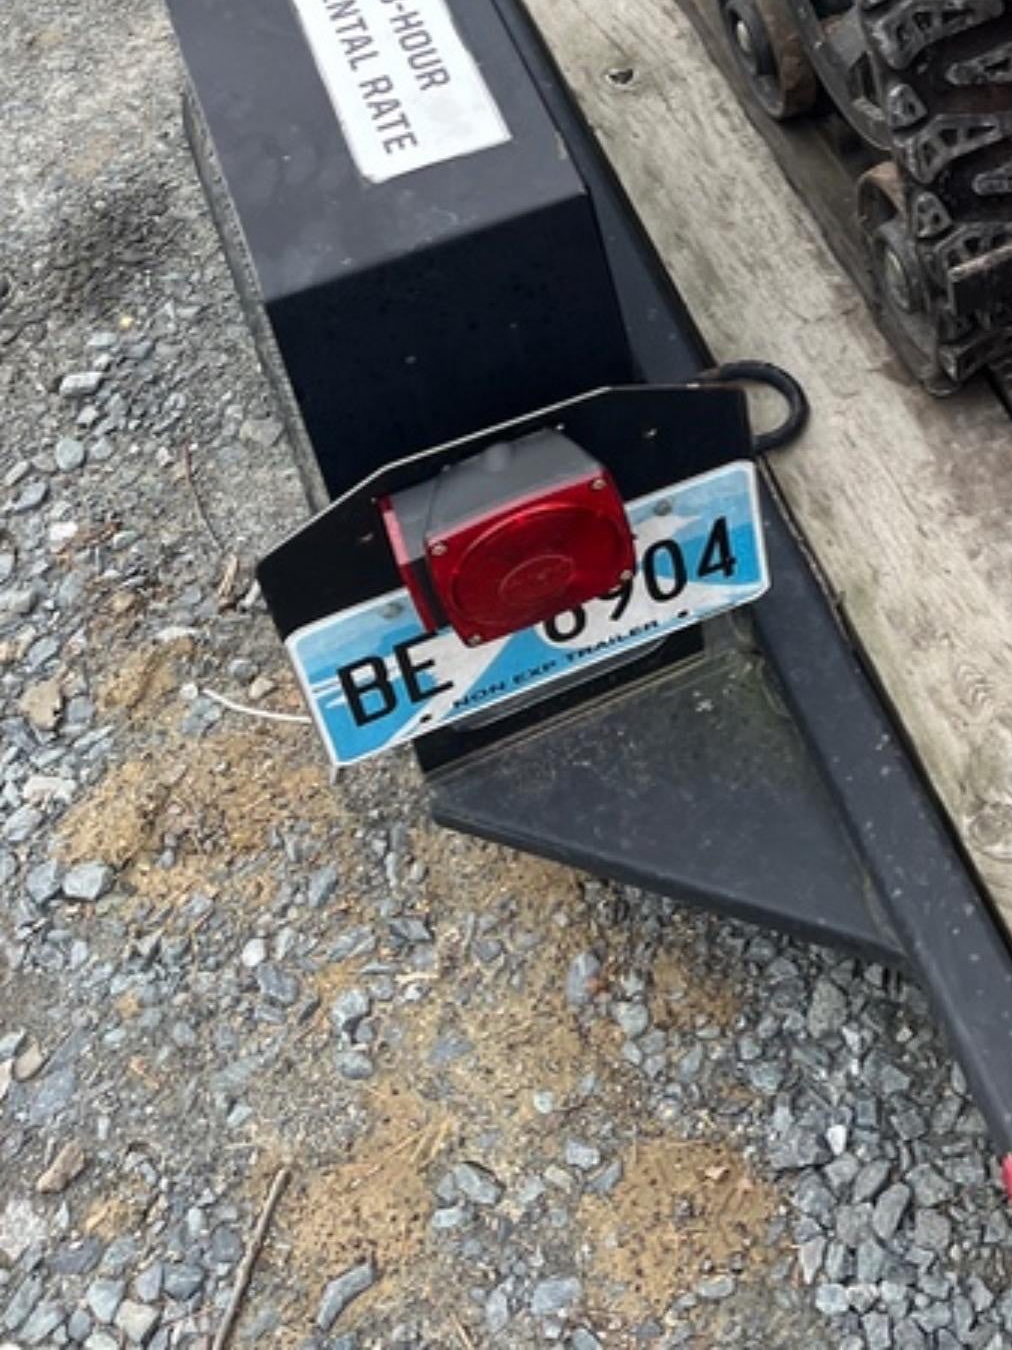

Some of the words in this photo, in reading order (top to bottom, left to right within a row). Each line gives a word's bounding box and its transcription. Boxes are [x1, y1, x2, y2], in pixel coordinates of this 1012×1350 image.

[358, 73, 418, 155] RATE
[336, 631, 455, 728] BE
[453, 678, 506, 709] NON
[512, 659, 557, 684] EXP
[564, 620, 659, 662] TRAILER
